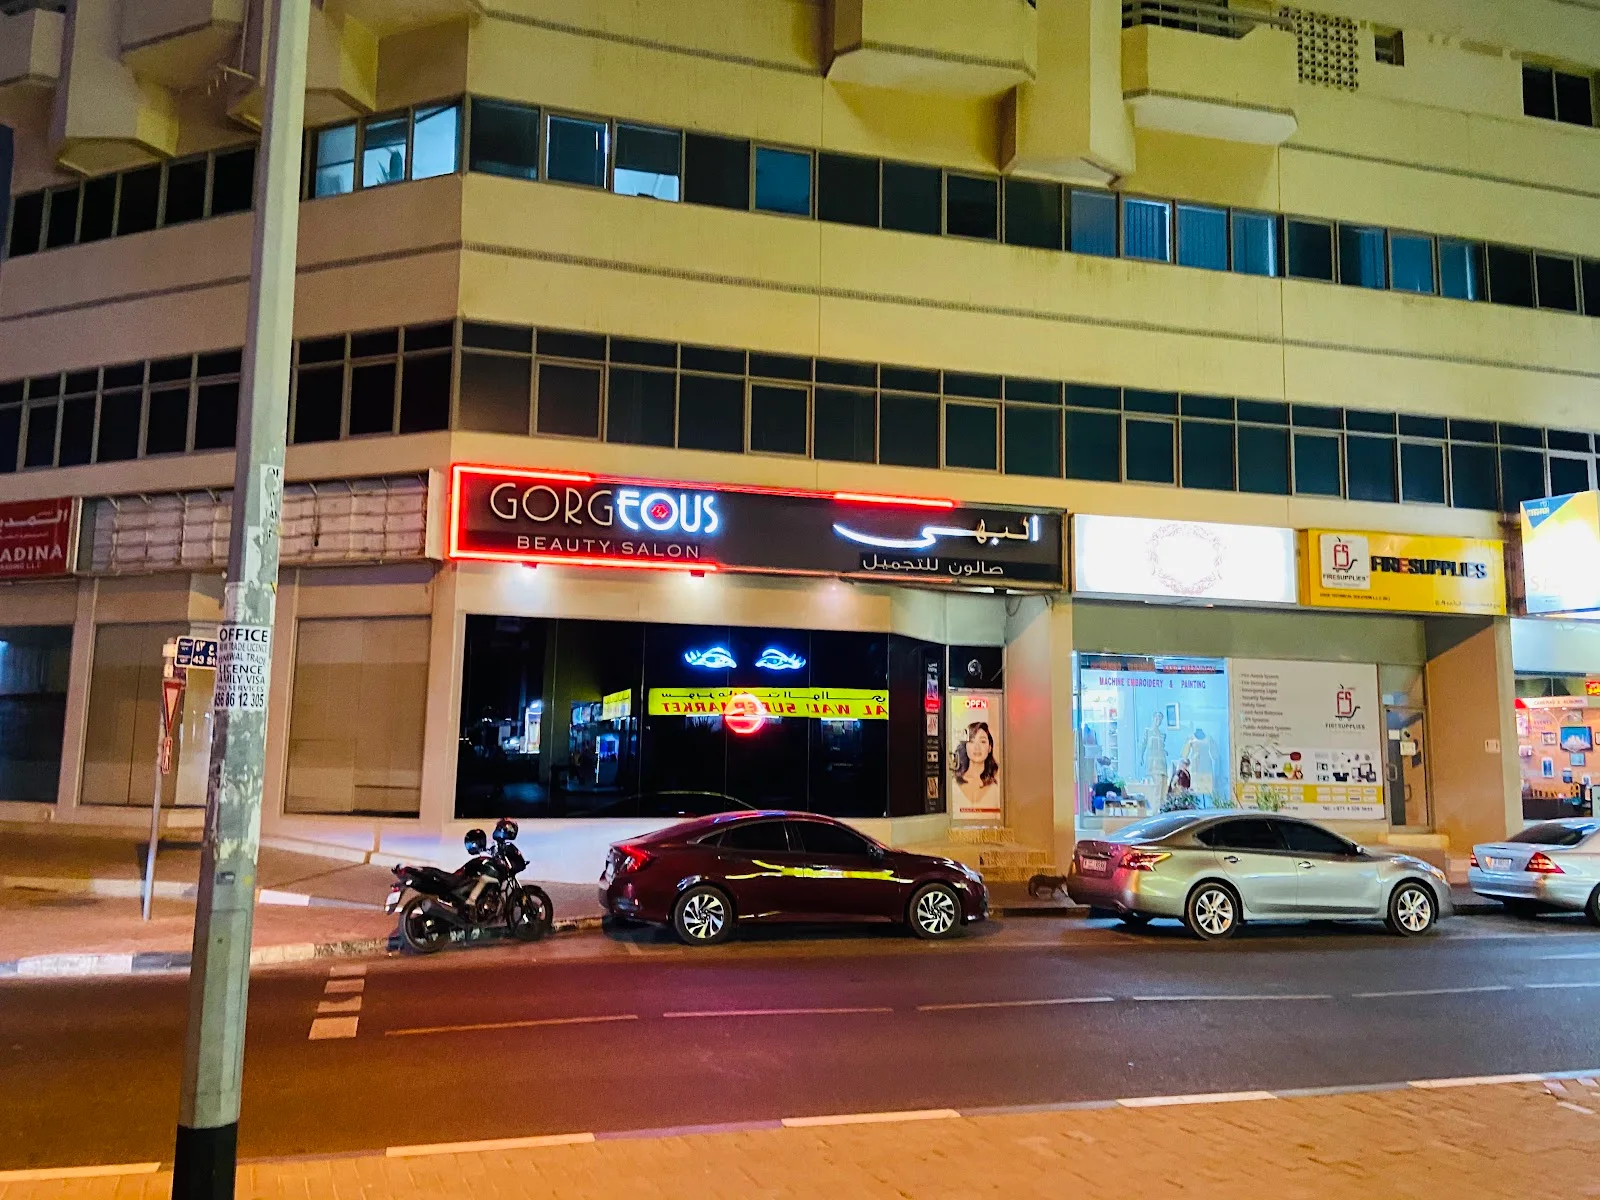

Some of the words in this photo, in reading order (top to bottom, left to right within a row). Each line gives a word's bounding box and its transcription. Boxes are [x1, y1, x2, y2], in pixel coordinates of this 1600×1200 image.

[490, 482, 719, 533] GORGEOUS
[517, 536, 610, 554] BEAUTY
[621, 541, 699, 559] SALON
[862, 554, 940, 572] للتجميل
[948, 559, 1004, 577] صالون
[1371, 555, 1488, 580] FIRESUPPLIES
[220, 628, 268, 643] OFFICE
[228, 642, 245, 652] TRADE
[192, 655, 205, 665] 43
[246, 653, 266, 666] TRADE
[219, 664, 263, 675] LICENCE
[245, 674, 265, 685] VISA
[1099, 677, 1125, 686] MACHINE
[1127, 678, 1163, 688] EMBROIDERY
[1181, 680, 1206, 689] PAINTING
[238, 693, 248, 707] 12
[250, 693, 264, 707] 305
[965, 699, 988, 709] OPEN
